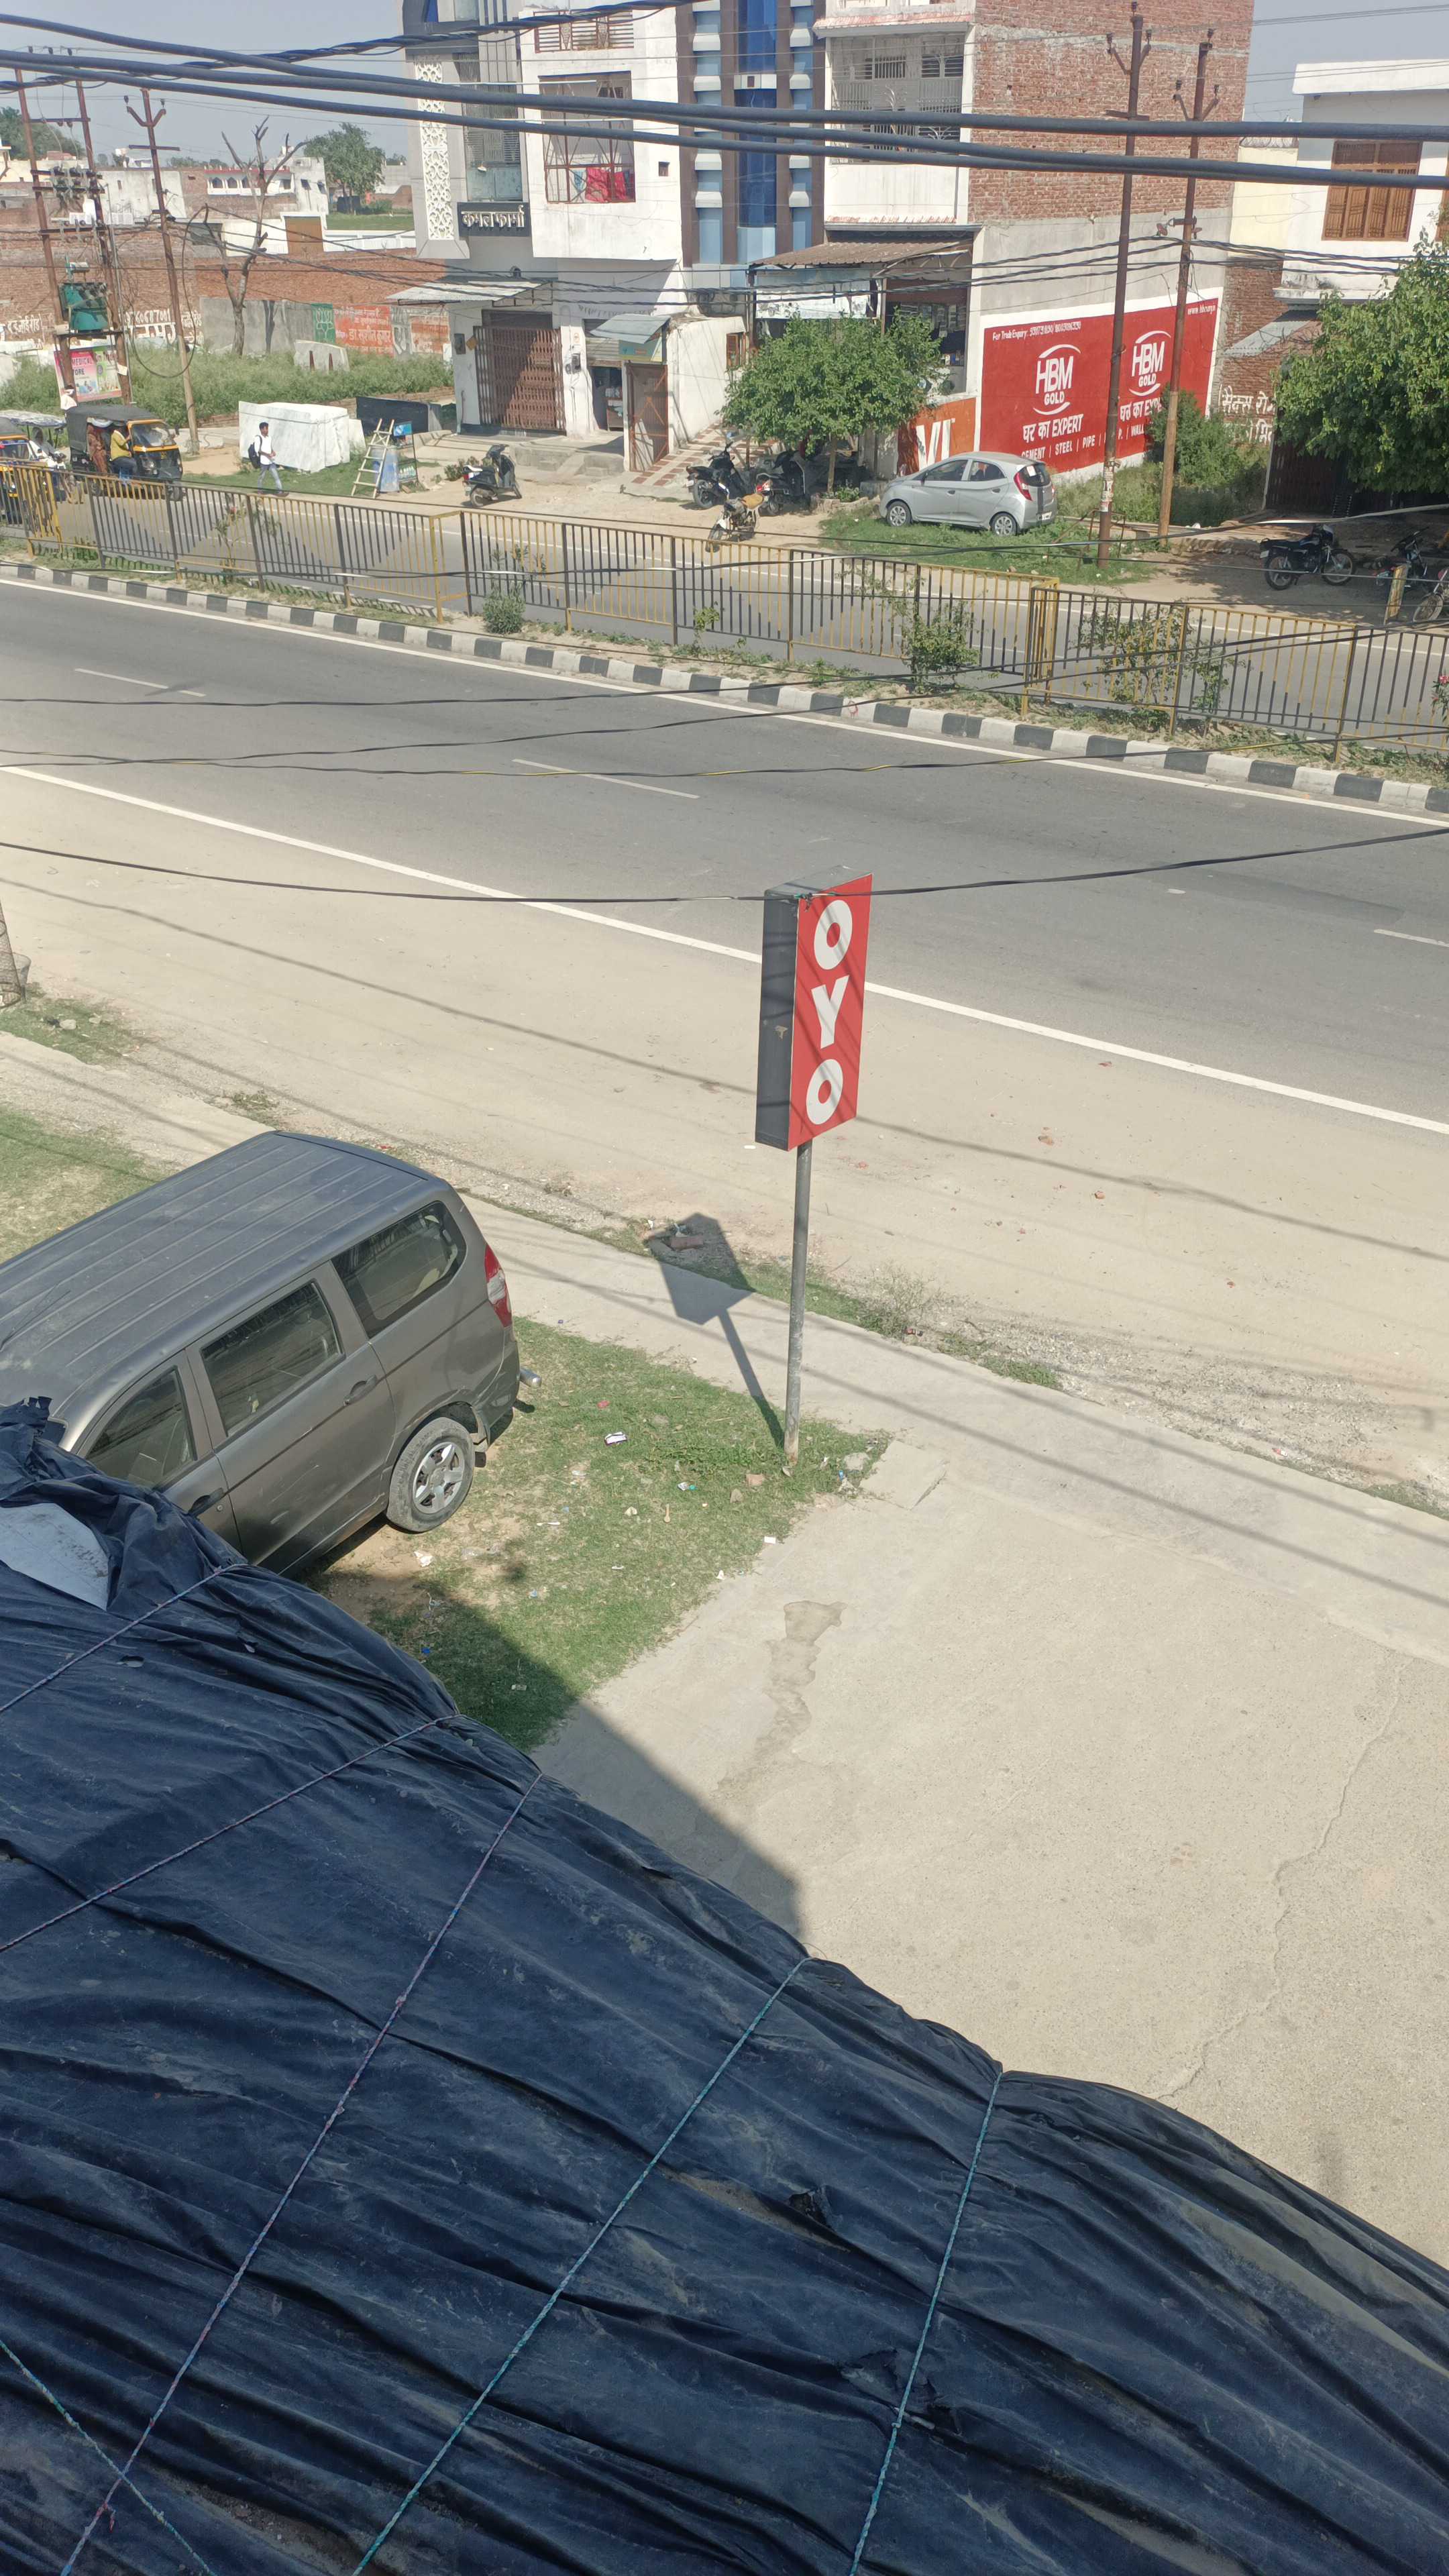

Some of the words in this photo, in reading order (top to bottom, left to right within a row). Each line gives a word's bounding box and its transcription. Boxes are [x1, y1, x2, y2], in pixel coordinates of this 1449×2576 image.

[462, 211, 494, 227] कमल
[495, 205, 525, 227] फार्मा
[1132, 341, 1165, 377] HBM
[1036, 356, 1073, 394] HBM
[1138, 374, 1157, 387] GOLD
[1044, 391, 1065, 406] GOLD
[1133, 400, 1144, 419] का
[1022, 423, 1036, 443] घर
[1038, 421, 1051, 441] का
[1051, 413, 1084, 438] EXPERT
[1055, 440, 1073, 456] STEEL
[1082, 435, 1095, 449] PIPE
[1131, 424, 1144, 437] WALL
[806, 899, 853, 1125] OYO
